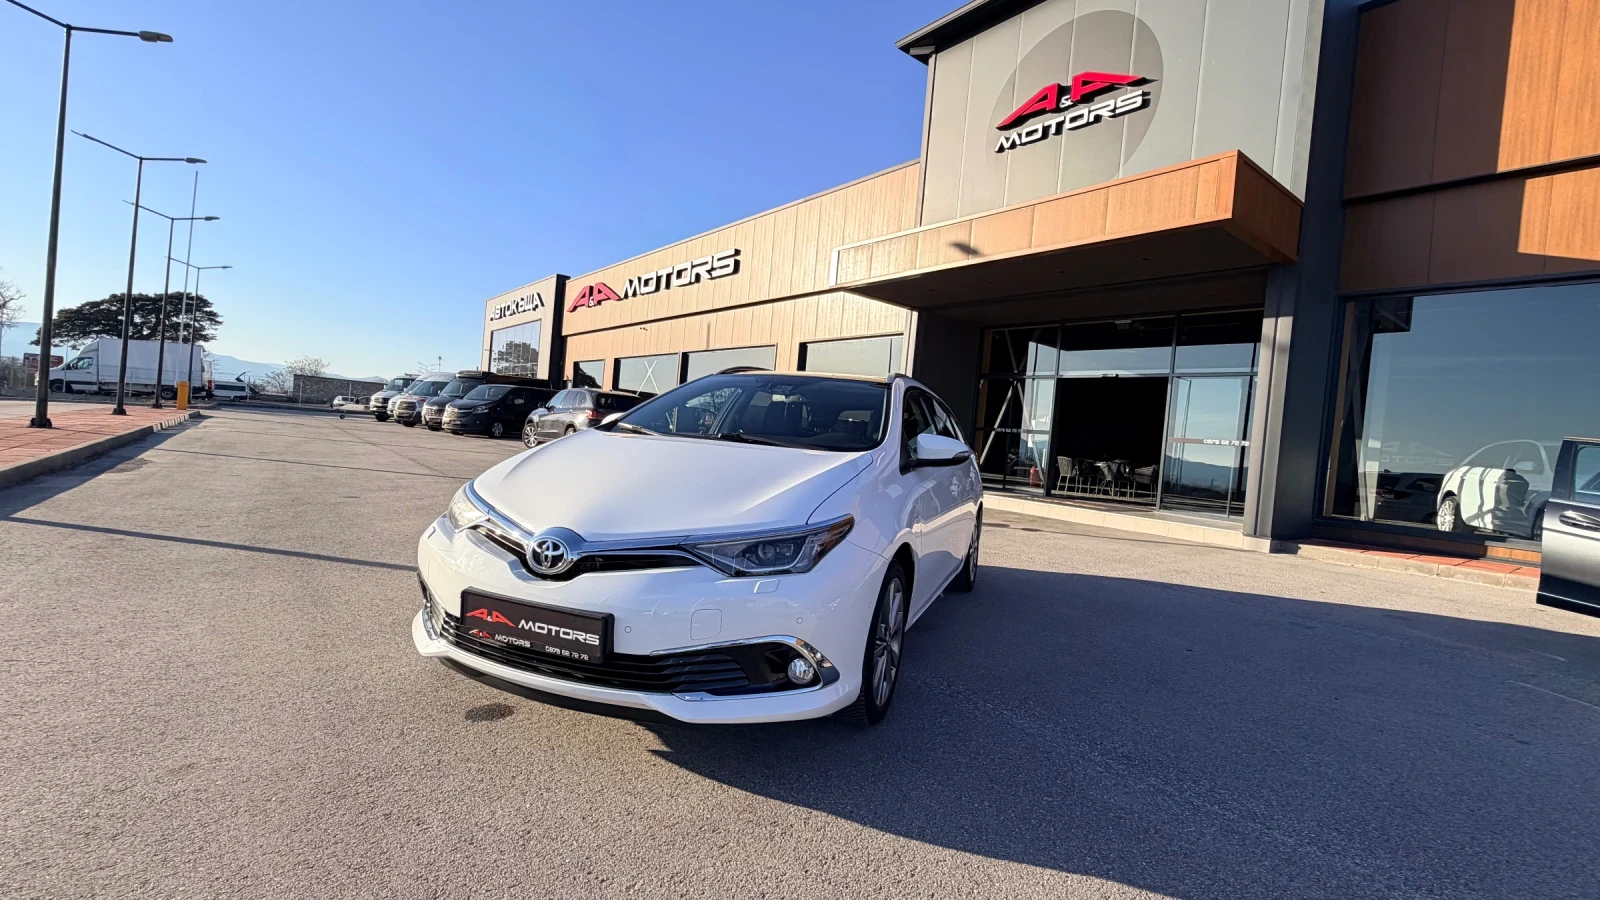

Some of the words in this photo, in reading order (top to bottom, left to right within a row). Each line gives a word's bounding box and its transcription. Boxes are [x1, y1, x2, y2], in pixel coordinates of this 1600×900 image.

[994, 90, 1144, 152] MOTORS
[996, 71, 1144, 129] A&A
[567, 282, 621, 312] A&A
[621, 248, 738, 299] MOTORS
[465, 608, 516, 627] A&A
[518, 619, 599, 646] MOTORS
[495, 633, 530, 648] MOTORS
[571, 651, 579, 659] 72
[580, 653, 589, 661] 72
